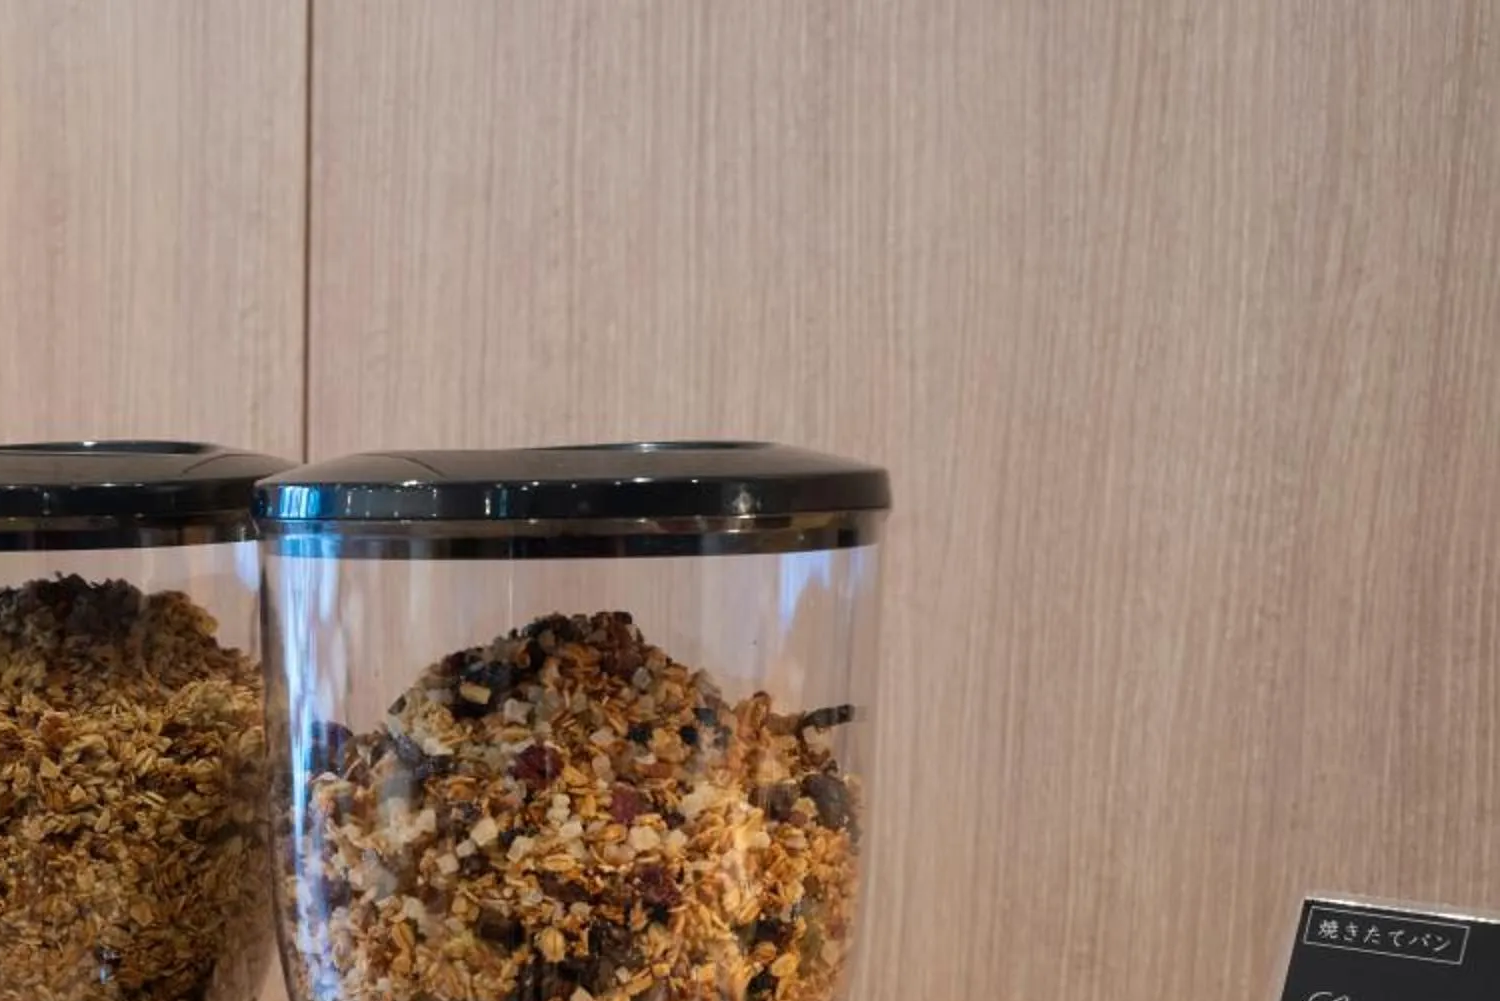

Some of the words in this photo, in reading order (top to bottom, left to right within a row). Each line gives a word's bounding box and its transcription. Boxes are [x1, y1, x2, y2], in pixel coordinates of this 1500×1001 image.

[1317, 918, 1451, 952] 焼きたてパン
